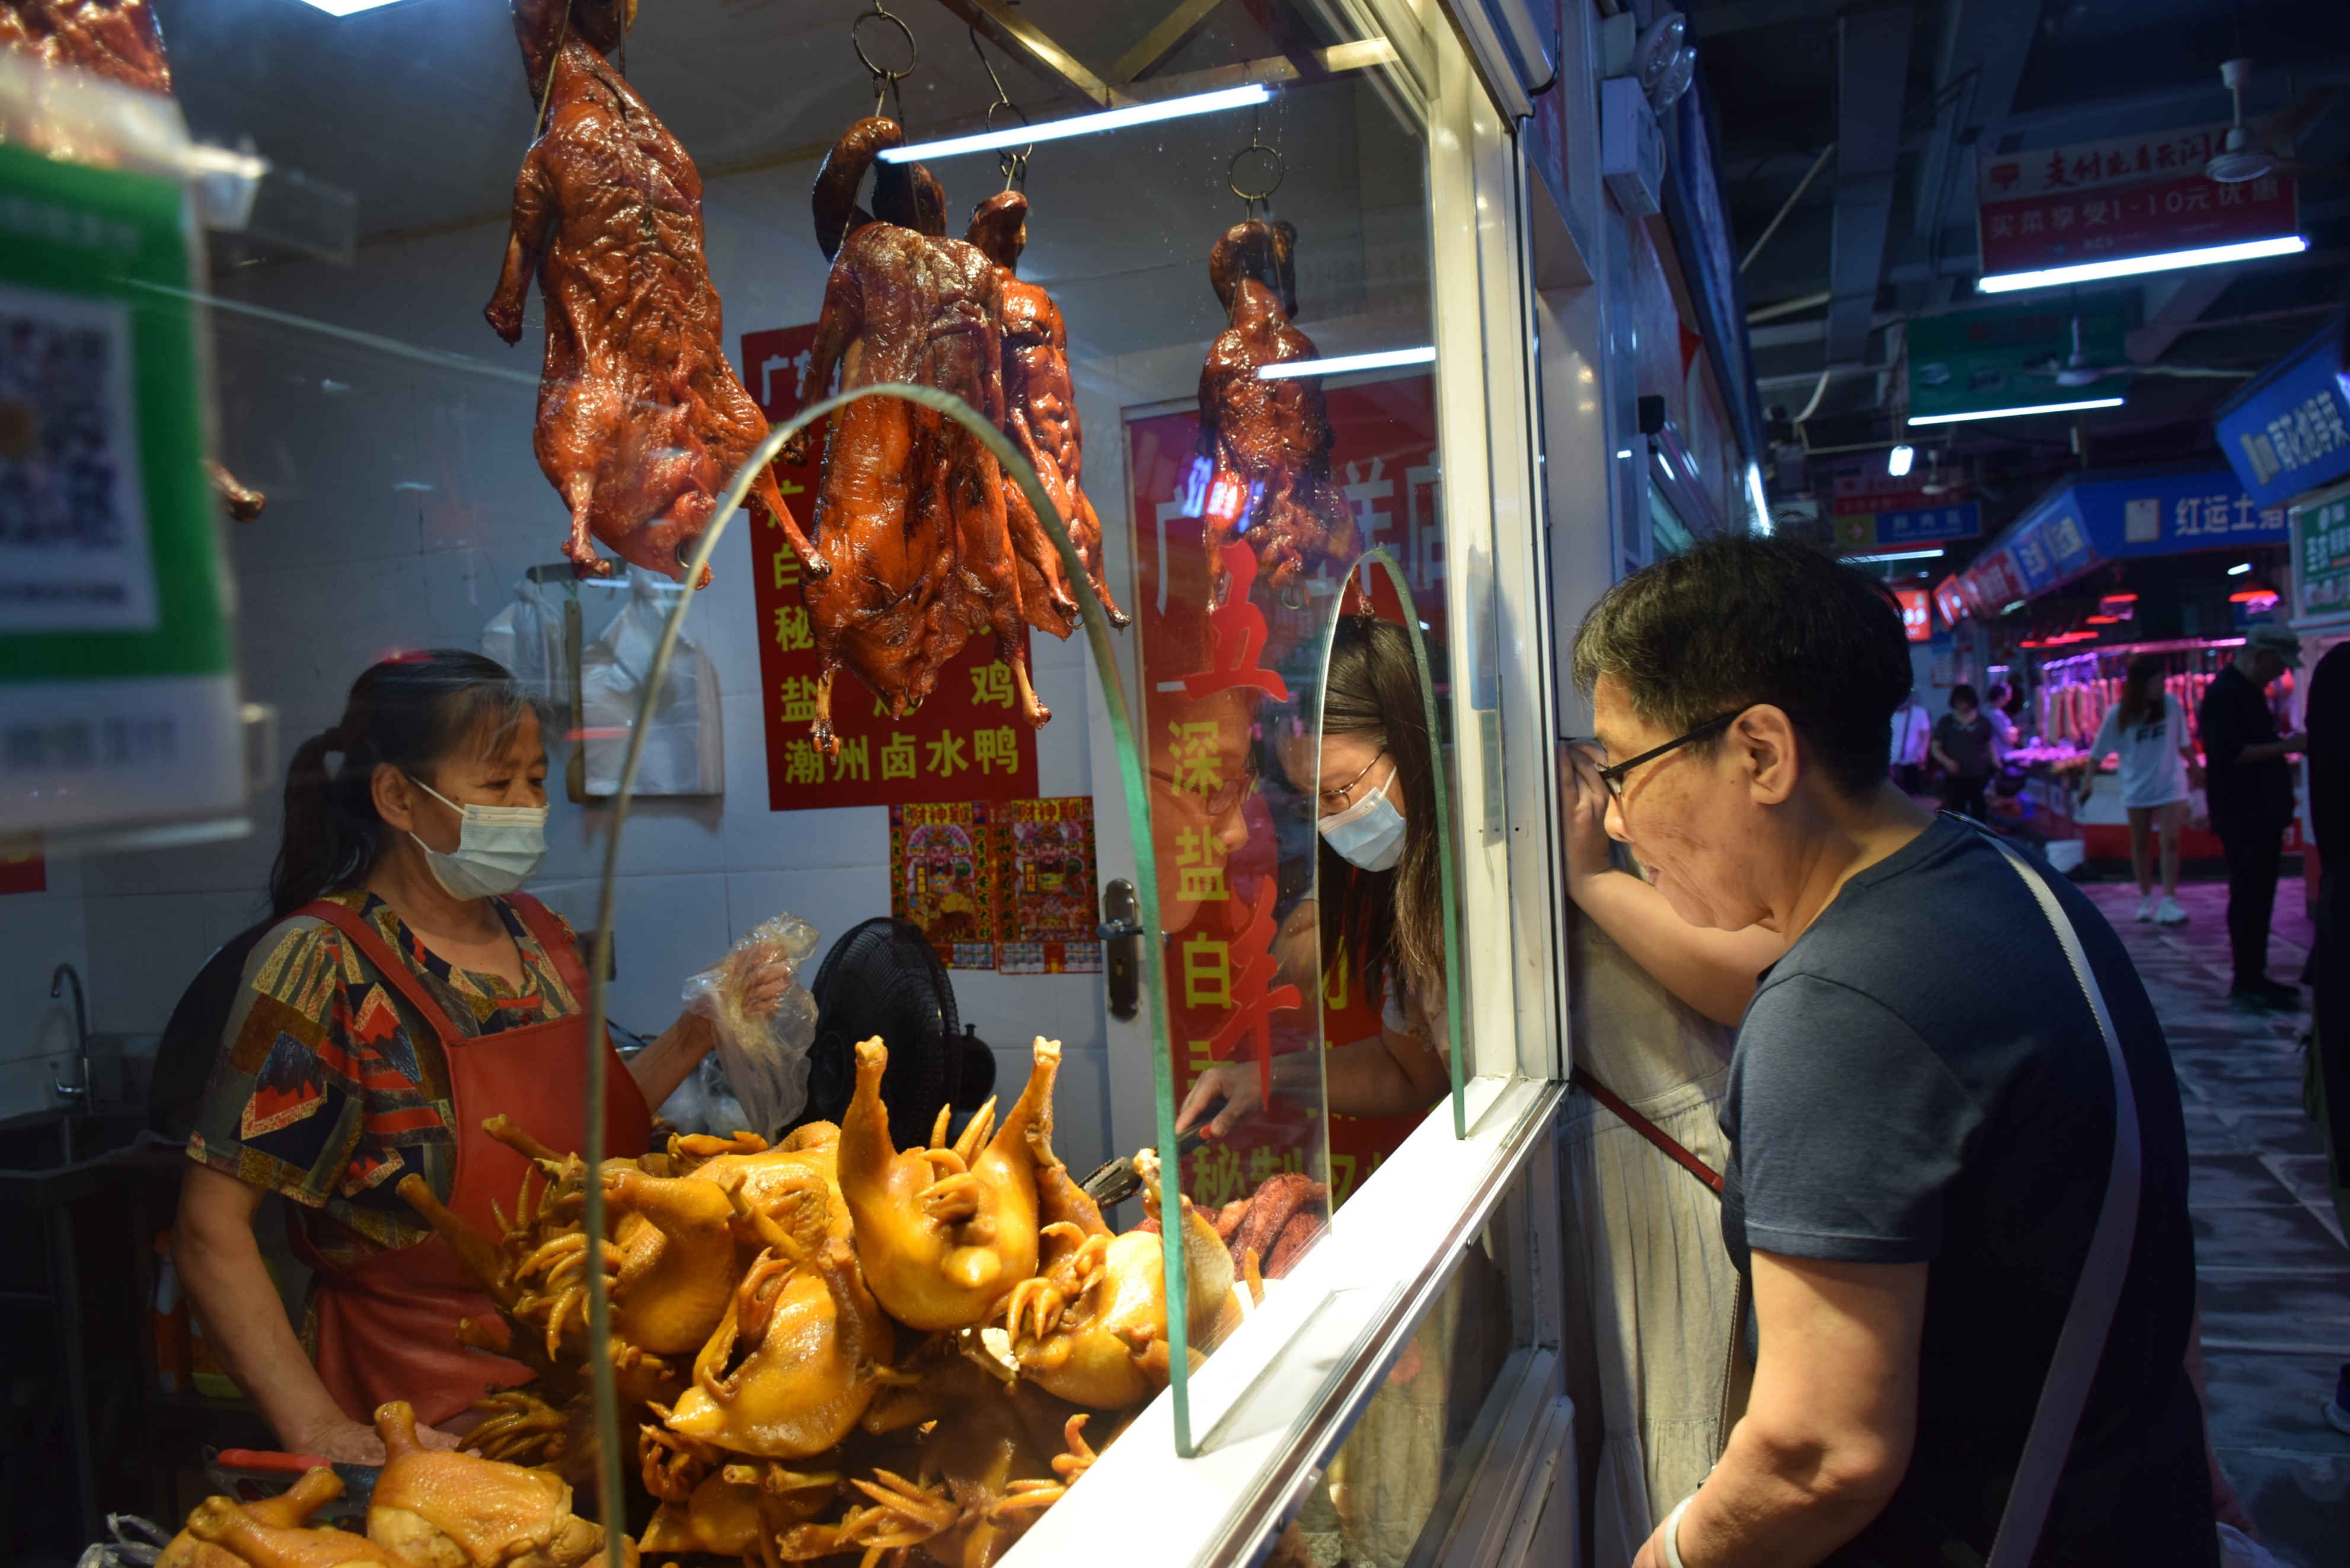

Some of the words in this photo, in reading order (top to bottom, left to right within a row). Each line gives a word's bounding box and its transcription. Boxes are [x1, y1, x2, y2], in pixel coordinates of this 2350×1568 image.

[785, 724, 1019, 784] 潮州卤水鸭
